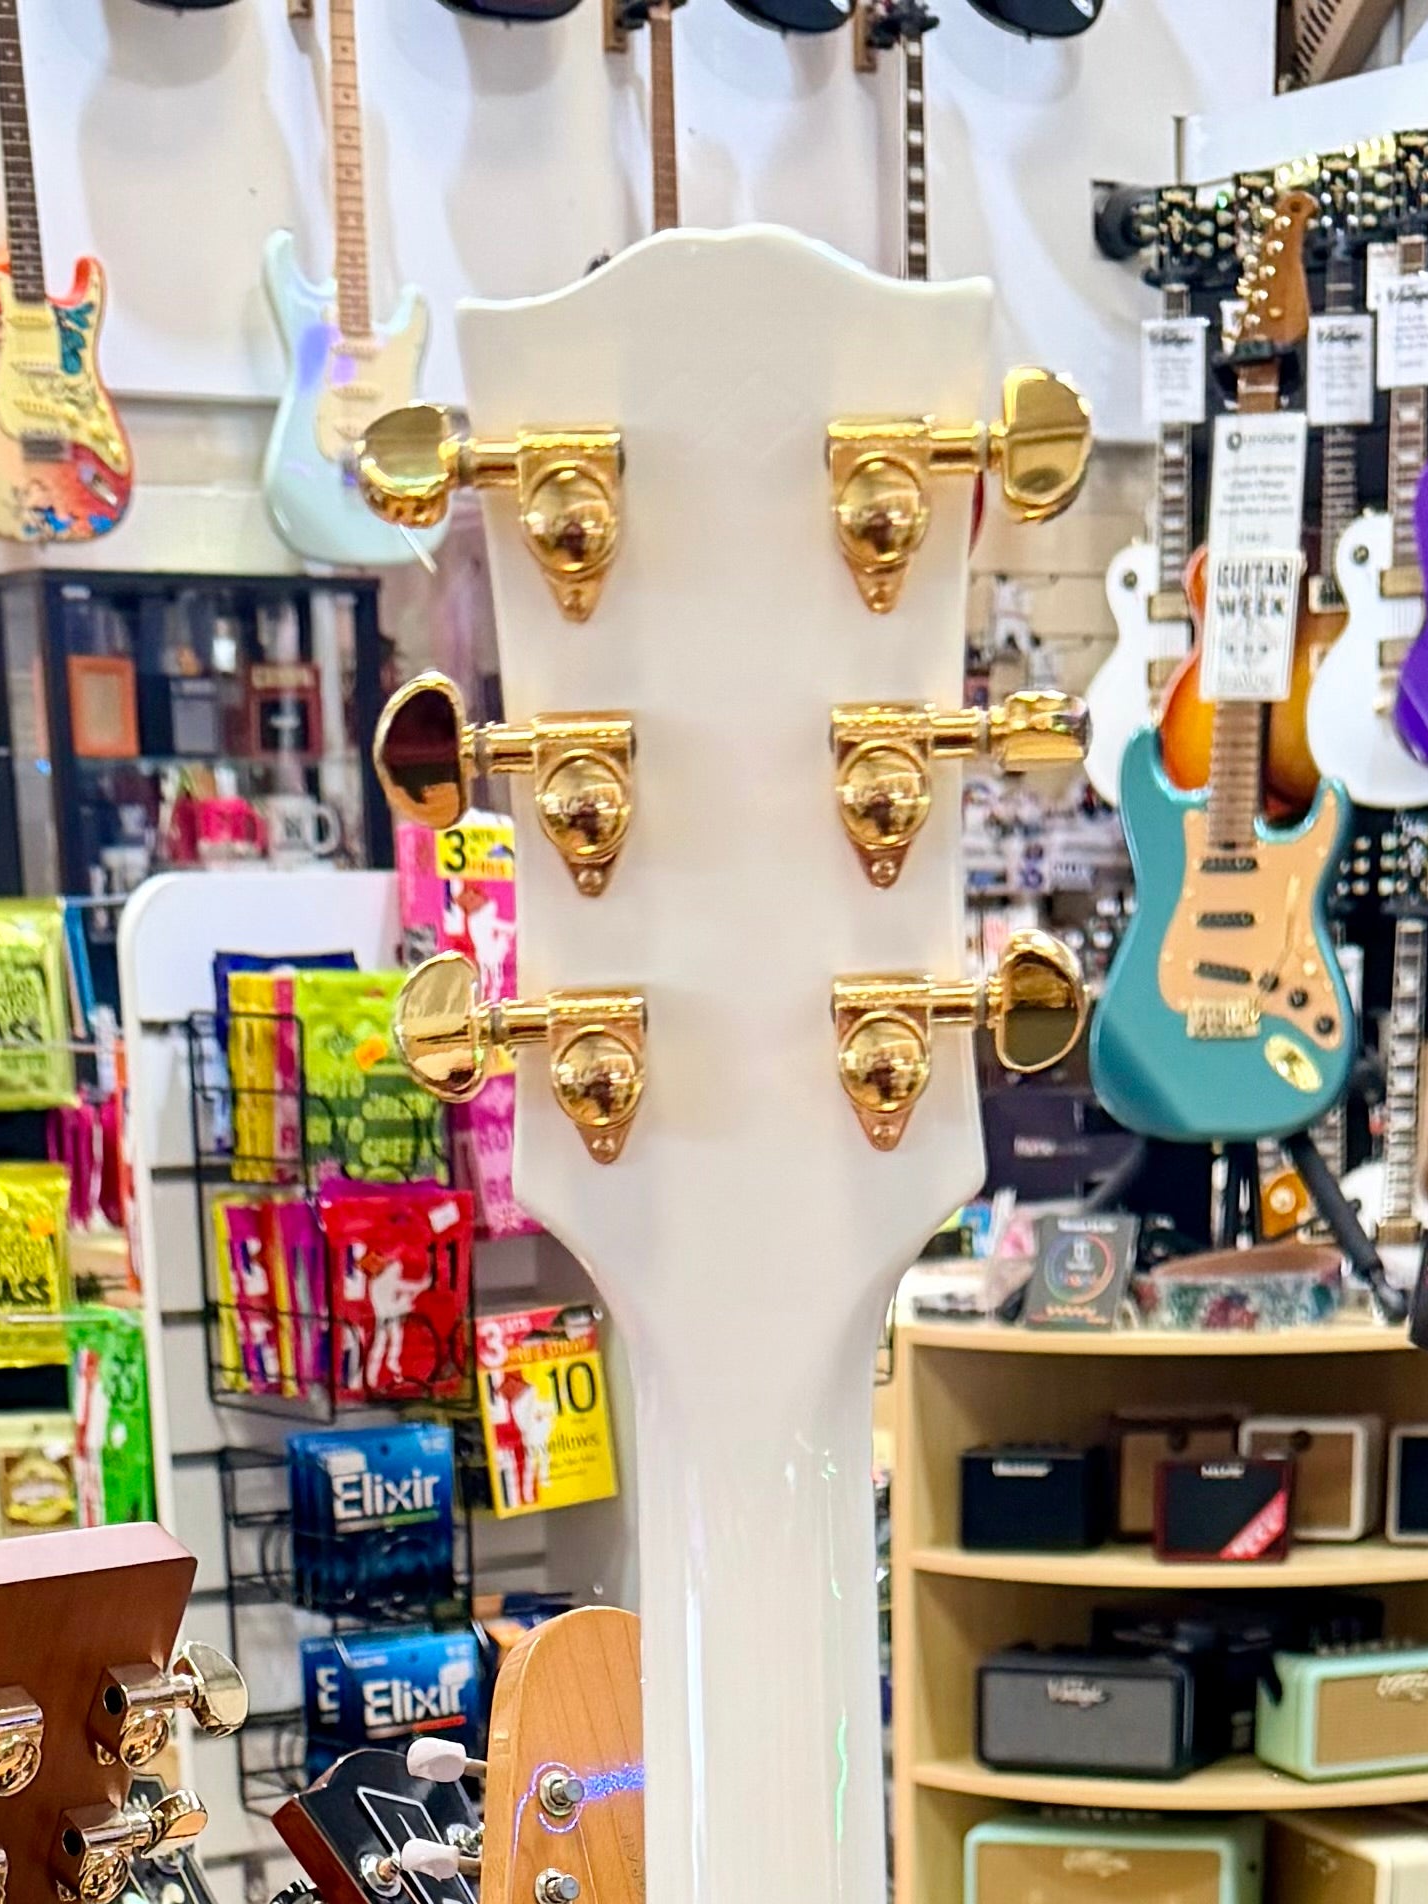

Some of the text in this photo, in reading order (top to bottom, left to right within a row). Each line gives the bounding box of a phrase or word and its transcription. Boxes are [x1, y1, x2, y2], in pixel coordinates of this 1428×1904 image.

[443, 829, 466, 873] 3
[478, 1321, 507, 1368] 3
[547, 1361, 597, 1417] 10
[331, 1467, 440, 1521] Elixir
[362, 1674, 465, 1725] Elixir
